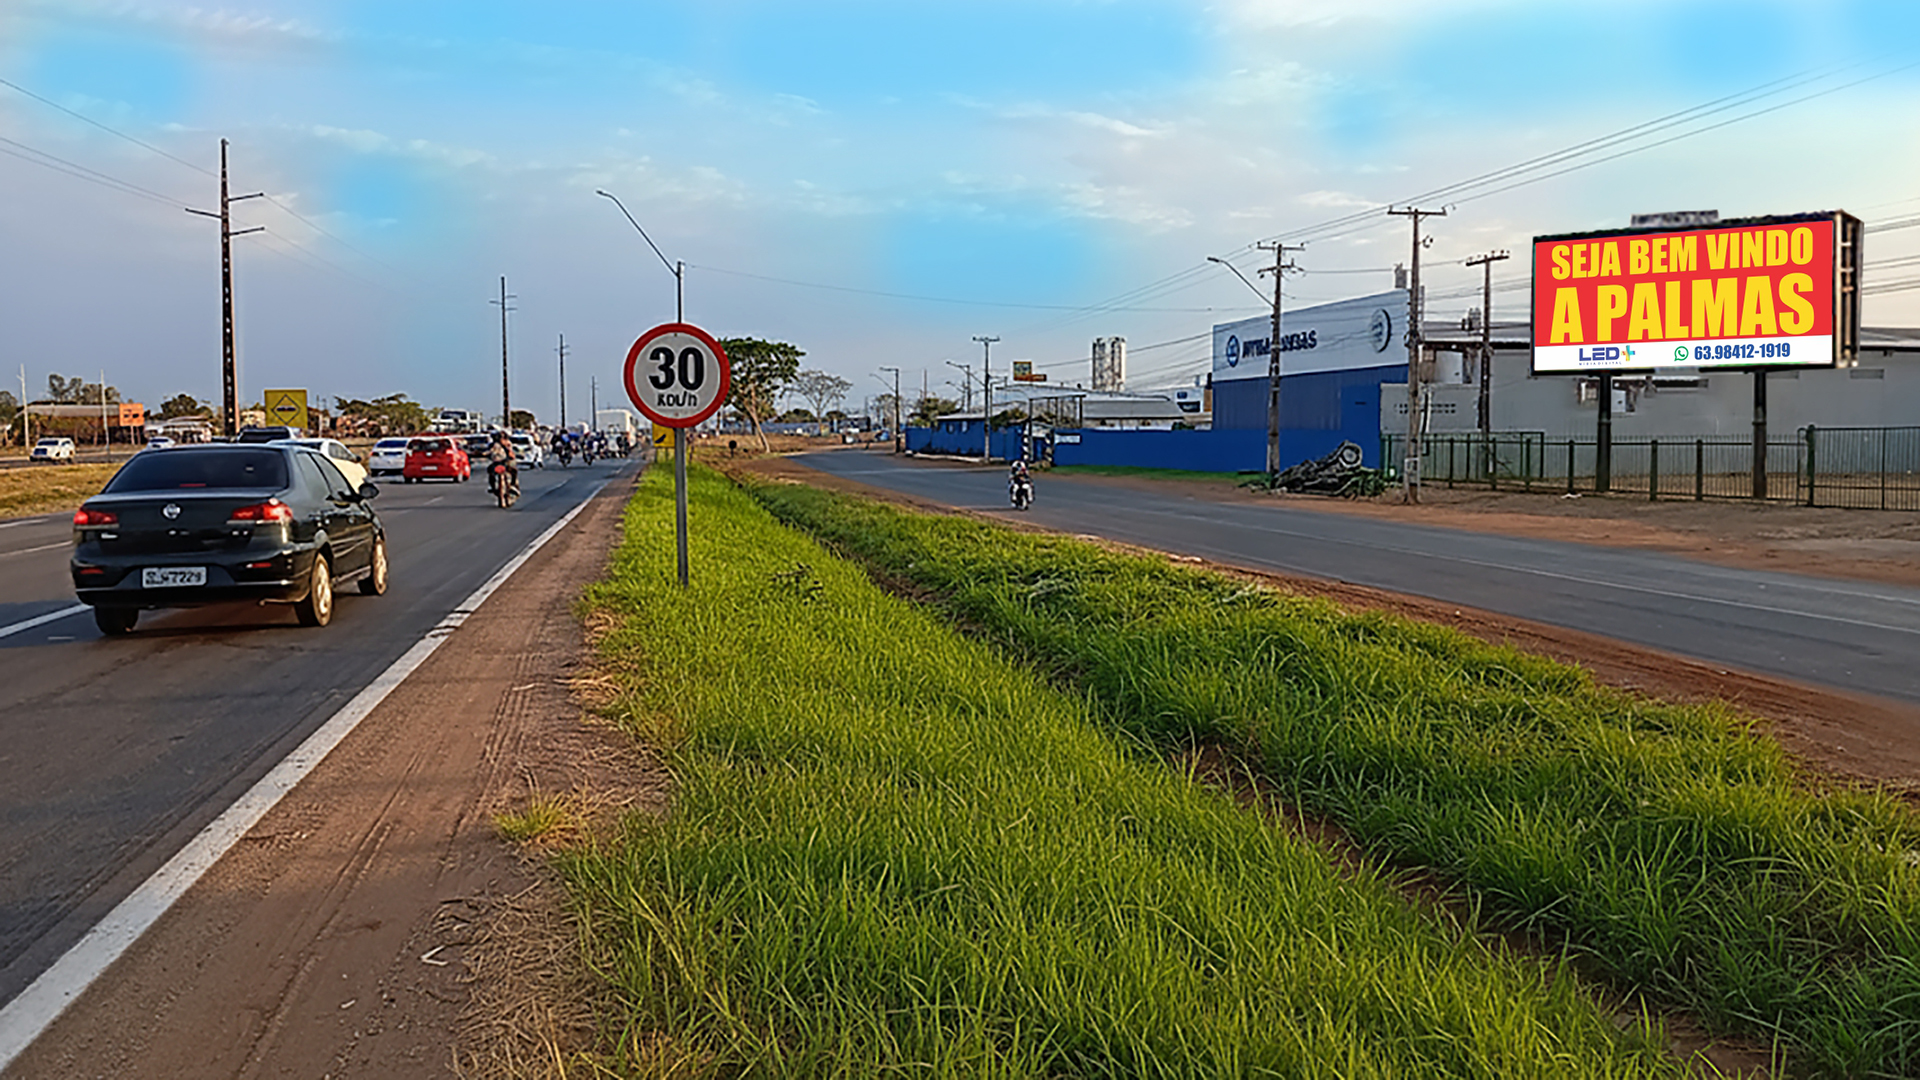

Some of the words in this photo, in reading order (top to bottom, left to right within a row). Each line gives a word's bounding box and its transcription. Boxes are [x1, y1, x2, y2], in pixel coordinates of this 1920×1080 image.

[1551, 242, 1622, 281] SEJA
[1629, 235, 1698, 275] BEM
[1705, 226, 1814, 270] VINDO
[1550, 287, 1584, 344] A
[1596, 272, 1815, 342] PALMAS
[648, 346, 705, 391] 30
[1694, 342, 1791, 361] 63.98412-1919
